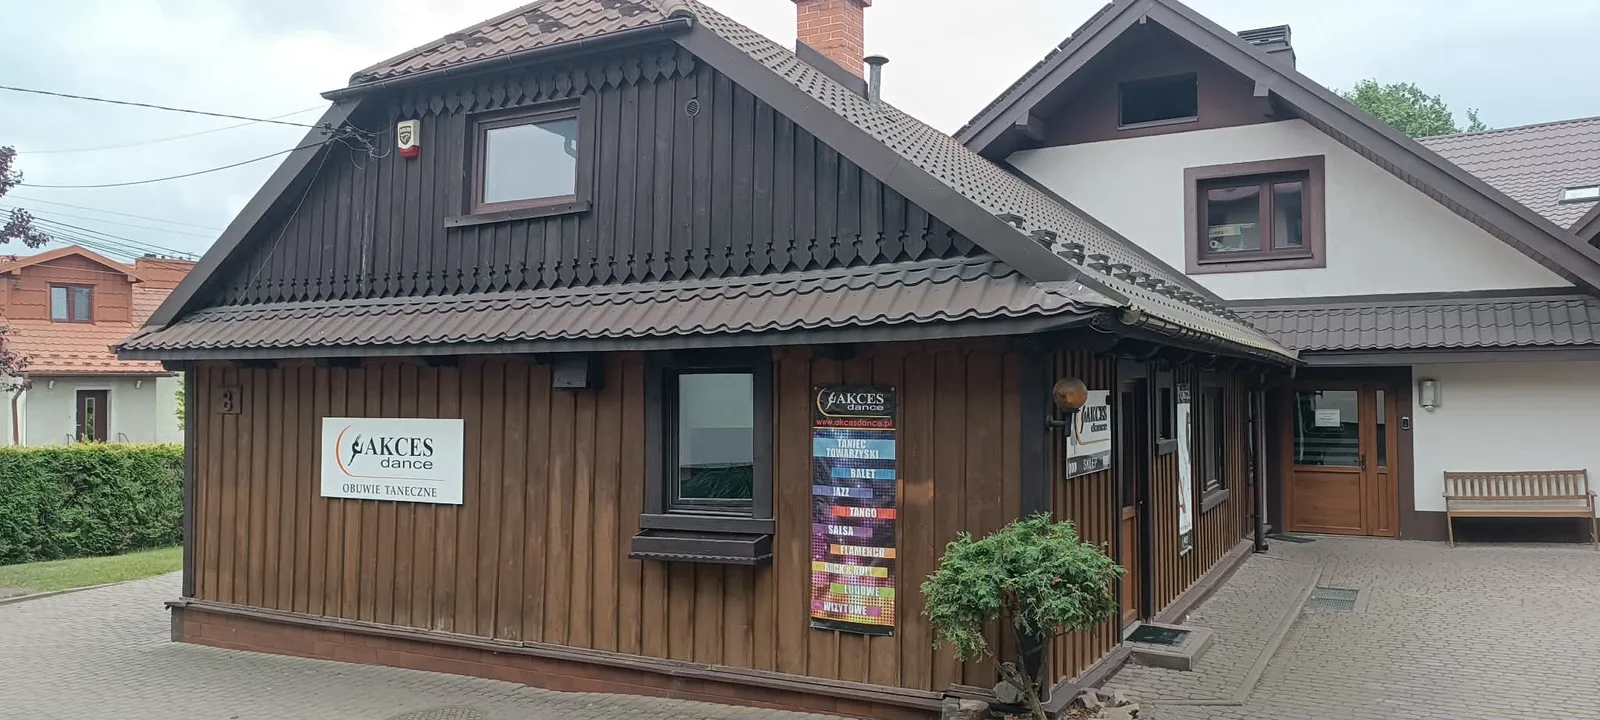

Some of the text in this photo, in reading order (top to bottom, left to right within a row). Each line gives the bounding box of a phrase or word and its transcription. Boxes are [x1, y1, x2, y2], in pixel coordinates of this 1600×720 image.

[837, 393, 884, 404] AKCES
[1084, 405, 1107, 422] AKCES
[816, 418, 893, 428] www.akcesdance.pl
[365, 437, 434, 457] AKCES
[837, 439, 866, 448] TANIEC
[826, 448, 879, 459] TOWARZYSKI
[380, 457, 433, 470] dance
[1082, 457, 1097, 470] SKLEP
[850, 468, 875, 478] BALET
[342, 483, 437, 498] OBUWIE TANECZNE
[833, 487, 850, 497] JAZZ
[849, 507, 877, 518] TANGO
[828, 524, 854, 536] SALSA
[840, 545, 885, 557] FLAMENCO
[824, 562, 873, 576] ROCK & ROLL
[844, 584, 880, 596] LUDOWE
[823, 601, 867, 615] WIZYTOWE
